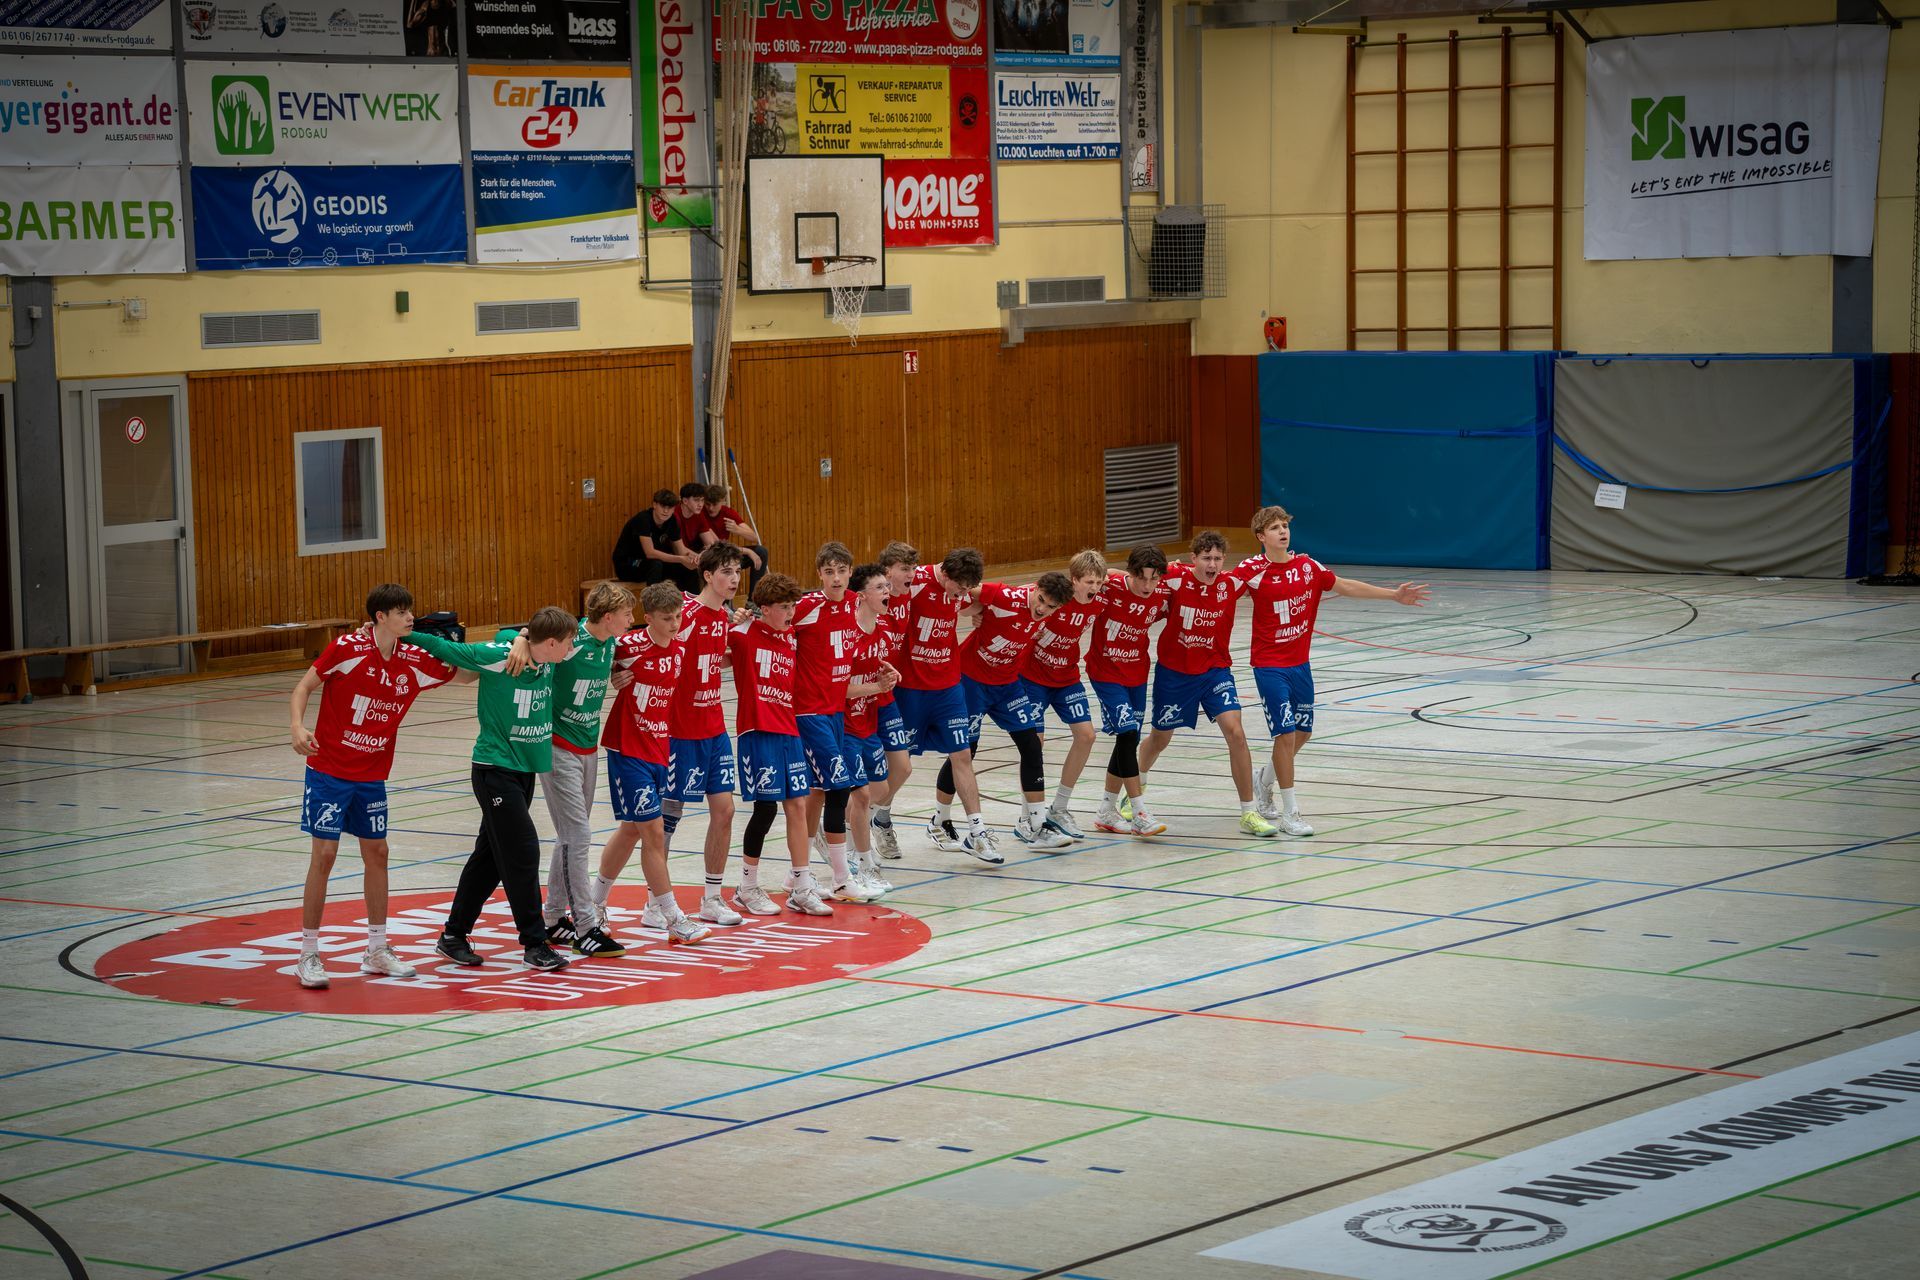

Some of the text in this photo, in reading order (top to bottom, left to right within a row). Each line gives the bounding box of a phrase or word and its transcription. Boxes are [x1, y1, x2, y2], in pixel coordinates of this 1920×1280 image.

[522, 1, 536, 12] ein
[476, 24, 554, 37] spannendes Spiel.
[568, 12, 616, 36] brass
[846, 6, 932, 42] Lieferservice
[82, 34, 154, 46] www.cfs-rodgau.de
[774, 39, 800, 52] 06106
[854, 42, 983, 58] www.papas-pizza-rodgau.de
[858, 80, 943, 90] VERKAUF REPARATUR
[494, 80, 606, 108] CarTank
[884, 93, 916, 102] SERVICE
[278, 92, 442, 121] EVENTWERK
[0, 94, 172, 134] yergigant.de
[869, 113, 932, 123] Tel.: 06106 21000
[281, 128, 328, 138] RODGAU
[526, 110, 573, 144] 24
[805, 121, 852, 134] Fahrrad
[809, 136, 850, 150] Schnur
[860, 139, 943, 150] www.fahrrad-schnur.de
[543, 154, 561, 162] Rodgau
[998, 146, 1027, 158] 10.000
[1029, 146, 1064, 158] Leuchten
[1067, 147, 1081, 157] auf
[1083, 146, 1106, 157] 1.700
[480, 179, 556, 188] Stark für die Menschen,
[1630, 177, 1670, 194] LET'S
[1676, 175, 1703, 188] END
[1709, 170, 1736, 184] THE
[480, 192, 498, 200] stark
[499, 191, 509, 199] für
[521, 191, 546, 201] Region.
[314, 195, 388, 216] GEODIS
[0, 201, 175, 240] BARMER
[898, 219, 979, 230] DER WOHN SPASS
[317, 221, 414, 236] We logistic your growth
[570, 234, 629, 243] Frankfurter Volksbank
[1286, 568, 1300, 584] 92
[1200, 585, 1208, 597] 2
[1290, 589, 1312, 607] Ninety
[844, 601, 850, 614] 4
[894, 604, 905, 620] 30
[1129, 603, 1145, 616] 99
[1290, 603, 1306, 616] One
[1070, 612, 1084, 625] 10
[1194, 618, 1216, 627] One
[712, 621, 723, 636] 25
[932, 629, 949, 638] One
[1024, 622, 1035, 633] 5
[1118, 631, 1138, 642] One
[659, 656, 672, 674] 89
[772, 663, 789, 676] One
[648, 697, 668, 708] One
[1222, 692, 1232, 705] 2
[370, 699, 404, 714] Ninety
[1069, 703, 1084, 718] 10
[366, 710, 388, 722] One
[1017, 709, 1027, 724] 5
[1294, 713, 1309, 727] 92
[889, 730, 905, 746] 30
[953, 730, 966, 745] 11
[721, 769, 734, 785] 25
[791, 774, 807, 791] 33
[370, 815, 385, 832] 18
[617, 922, 870, 967] MARKT
[1496, 1088, 1908, 1206] AN UNS KOMMST
